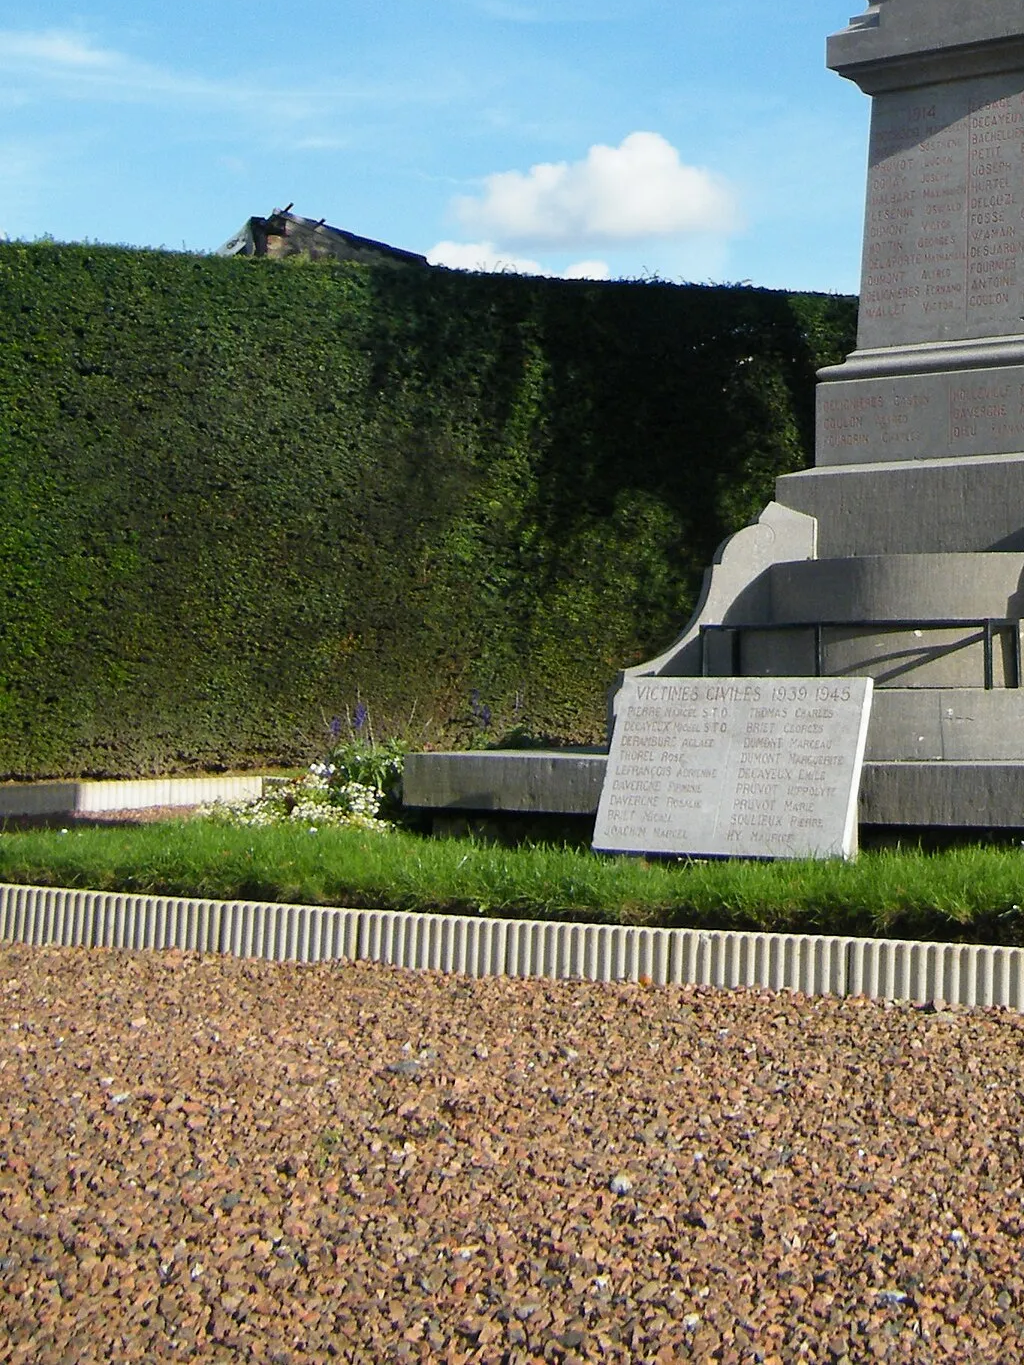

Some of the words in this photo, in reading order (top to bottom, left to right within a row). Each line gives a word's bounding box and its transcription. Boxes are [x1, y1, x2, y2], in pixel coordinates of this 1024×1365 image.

[636, 685, 699, 701] VICTIMES
[706, 685, 761, 702] CIVILES
[772, 685, 808, 702] 1939
[815, 685, 851, 702] 1945
